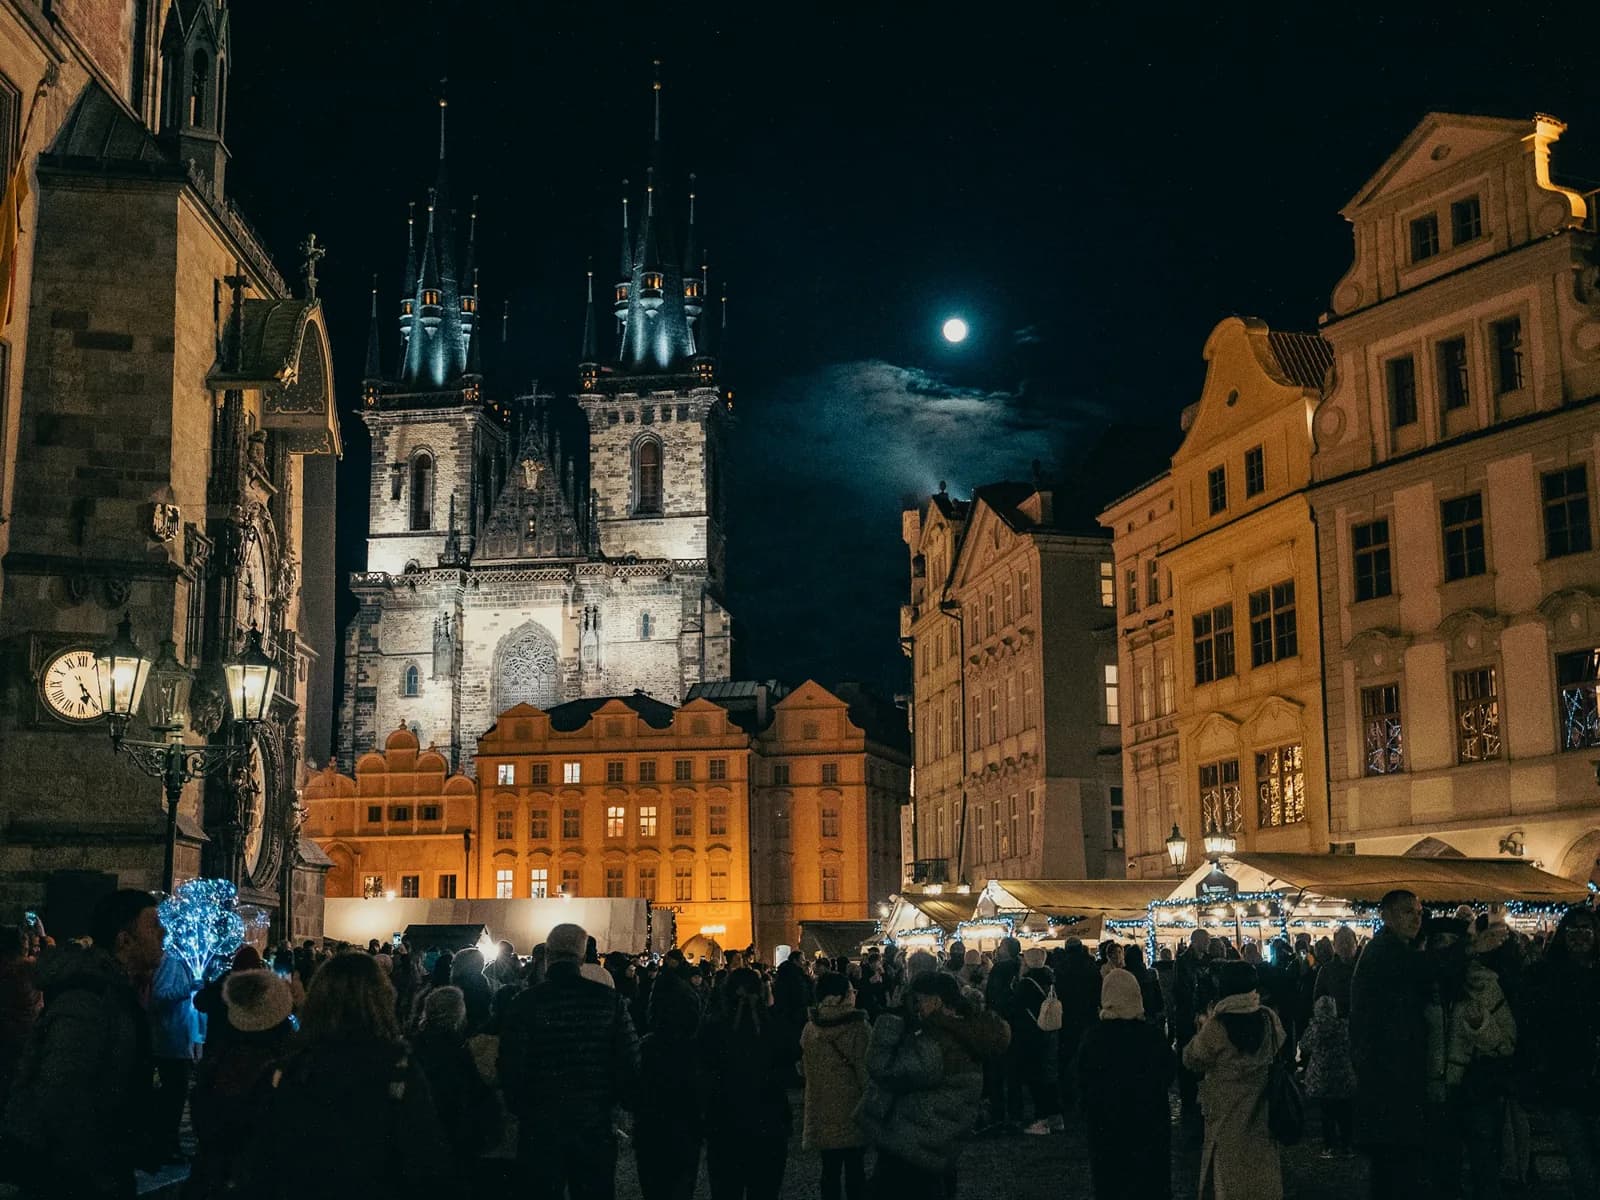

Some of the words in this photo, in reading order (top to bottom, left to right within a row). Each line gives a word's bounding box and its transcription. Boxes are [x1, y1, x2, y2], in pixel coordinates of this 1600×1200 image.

[64, 658, 75, 670] XI
[77, 656, 88, 667] XII
[54, 667, 66, 677] X
[78, 704, 85, 714] VI
